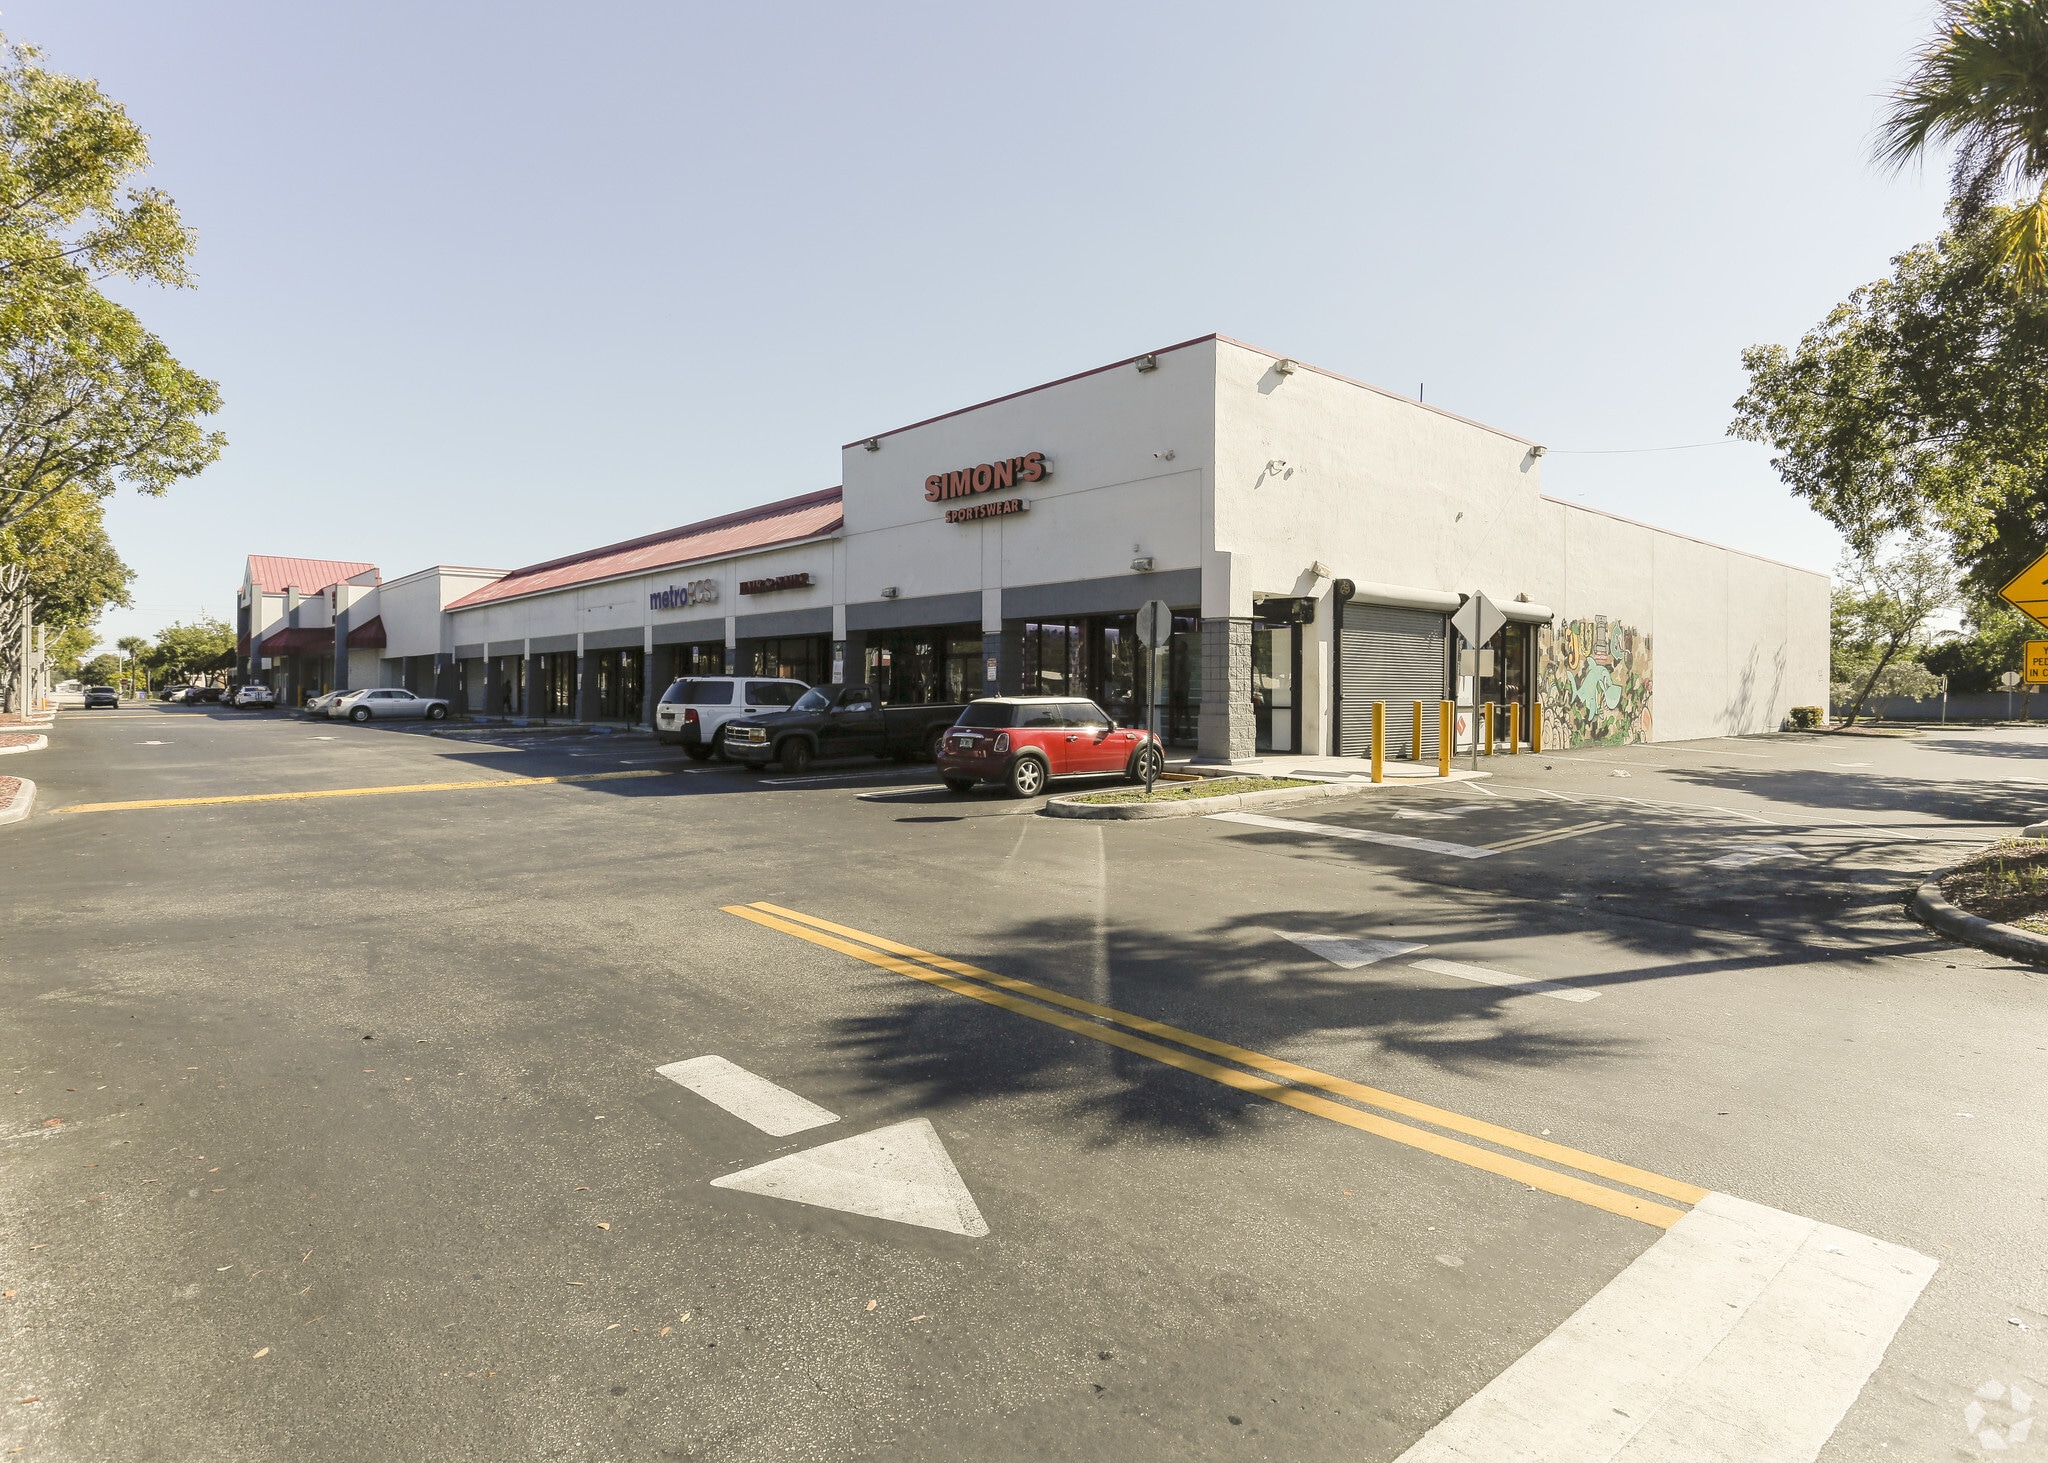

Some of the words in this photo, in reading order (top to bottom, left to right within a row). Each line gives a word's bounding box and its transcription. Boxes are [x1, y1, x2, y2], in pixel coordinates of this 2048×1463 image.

[924, 452, 1045, 502] SIMON'S
[945, 499, 1021, 523] SPORTSWEAR
[650, 578, 713, 610] metroPCS
[2029, 669, 2039, 677] IN
